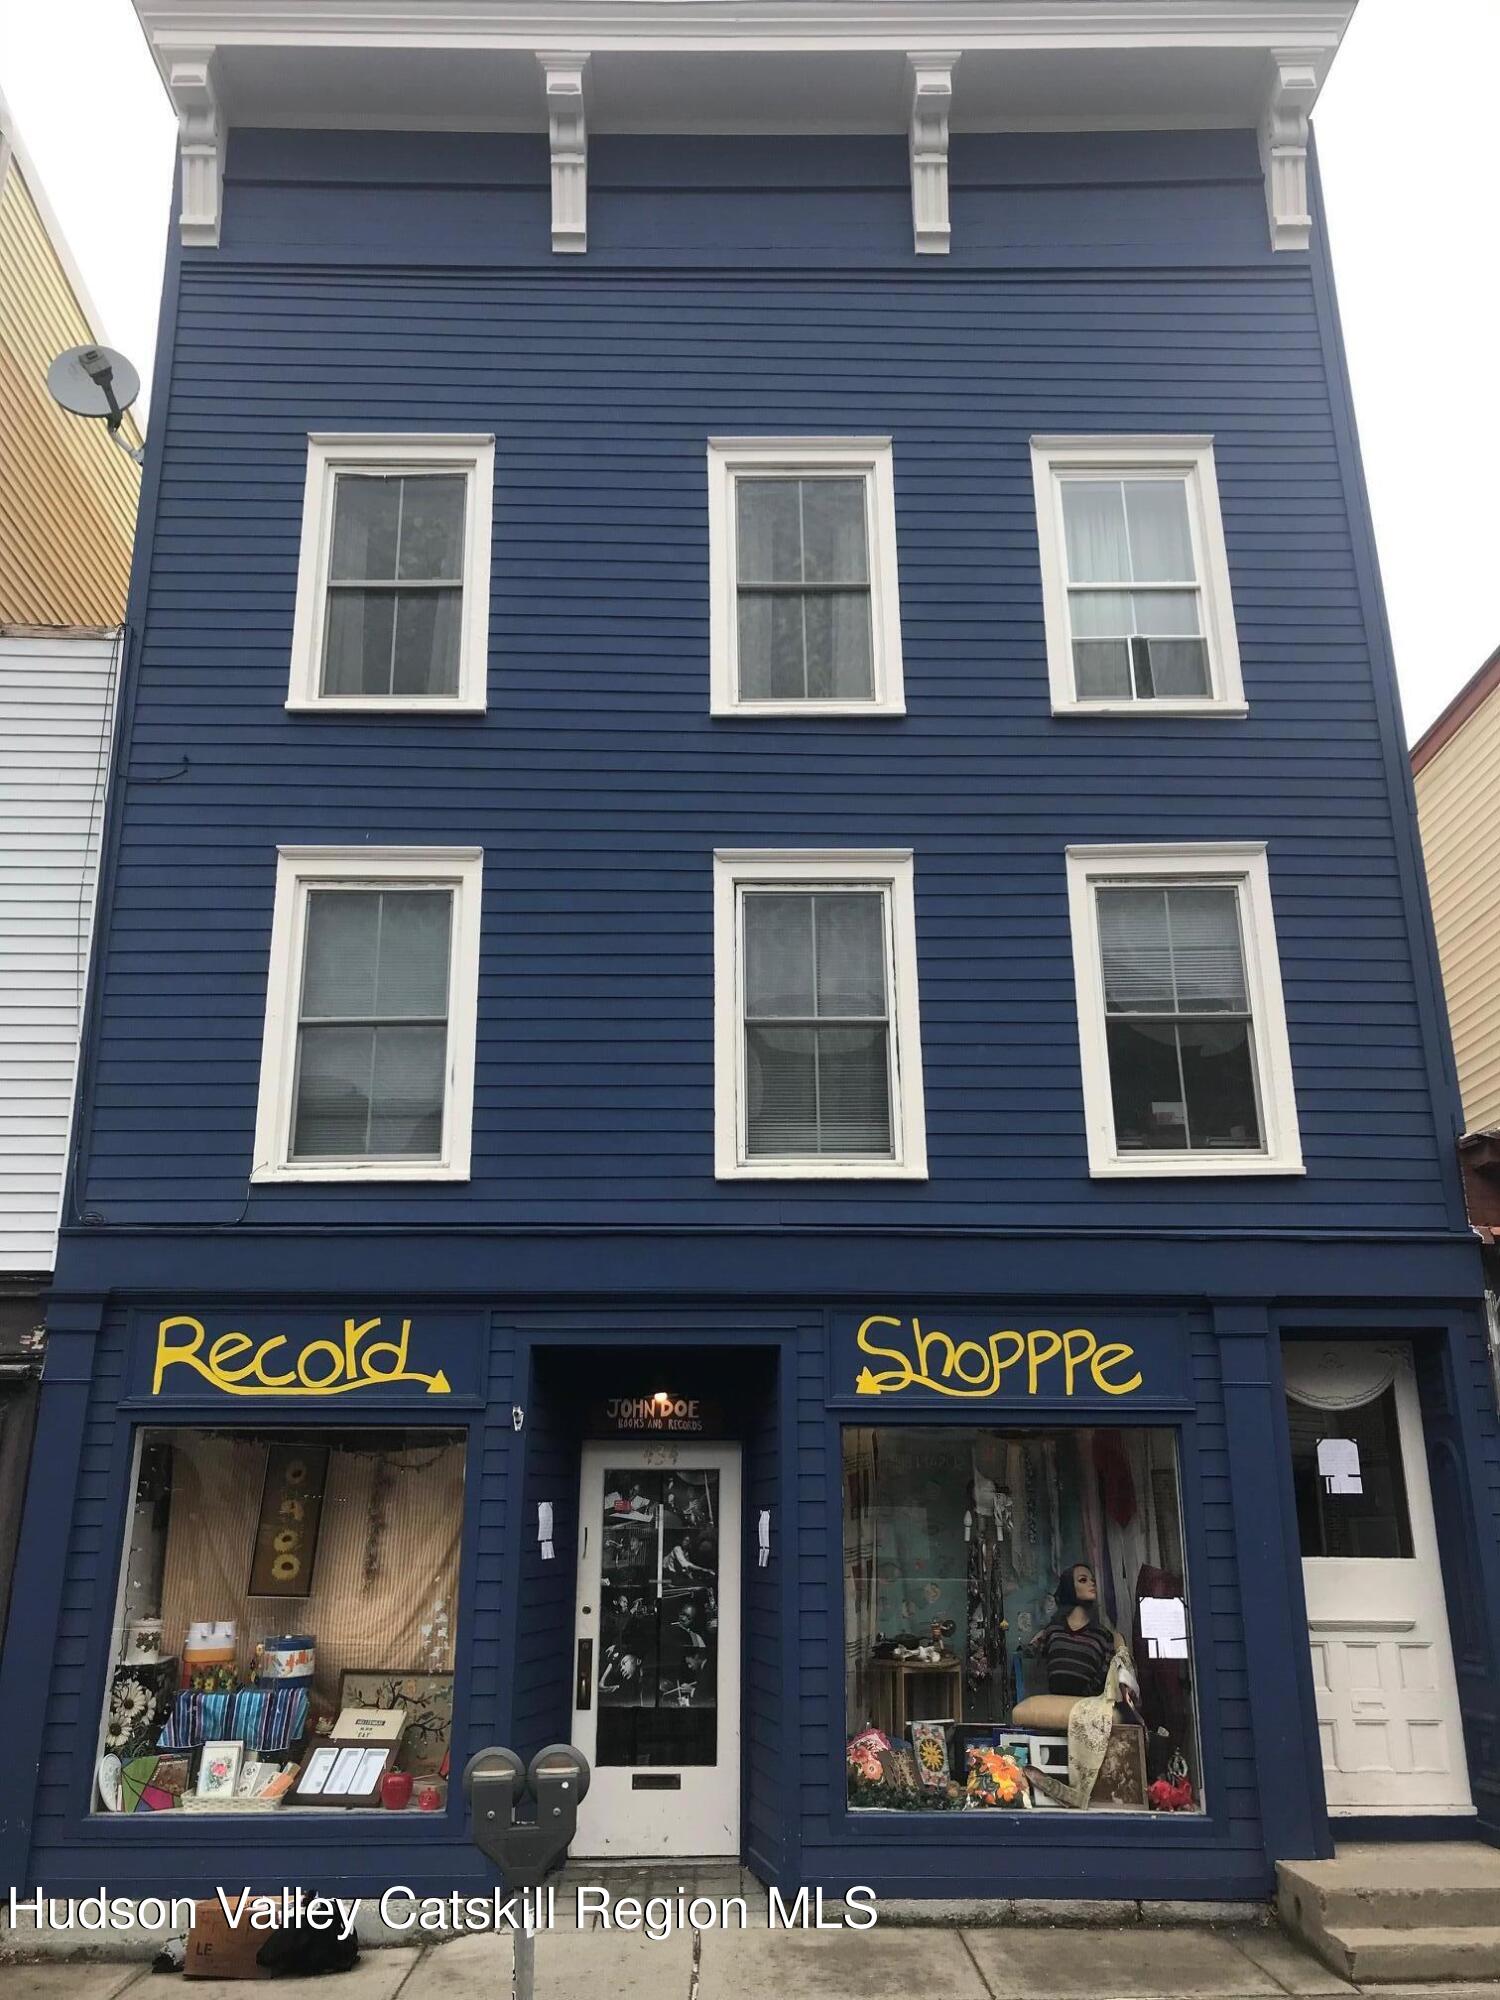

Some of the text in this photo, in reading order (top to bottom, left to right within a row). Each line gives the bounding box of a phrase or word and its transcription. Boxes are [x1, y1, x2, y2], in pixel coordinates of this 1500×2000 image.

[153, 1316, 451, 1394] Record
[857, 1315, 1143, 1396] Shopppe
[607, 1399, 700, 1418] JOHN DOE
[648, 1419, 662, 1430] AND
[668, 1419, 703, 1431] RECORDS
